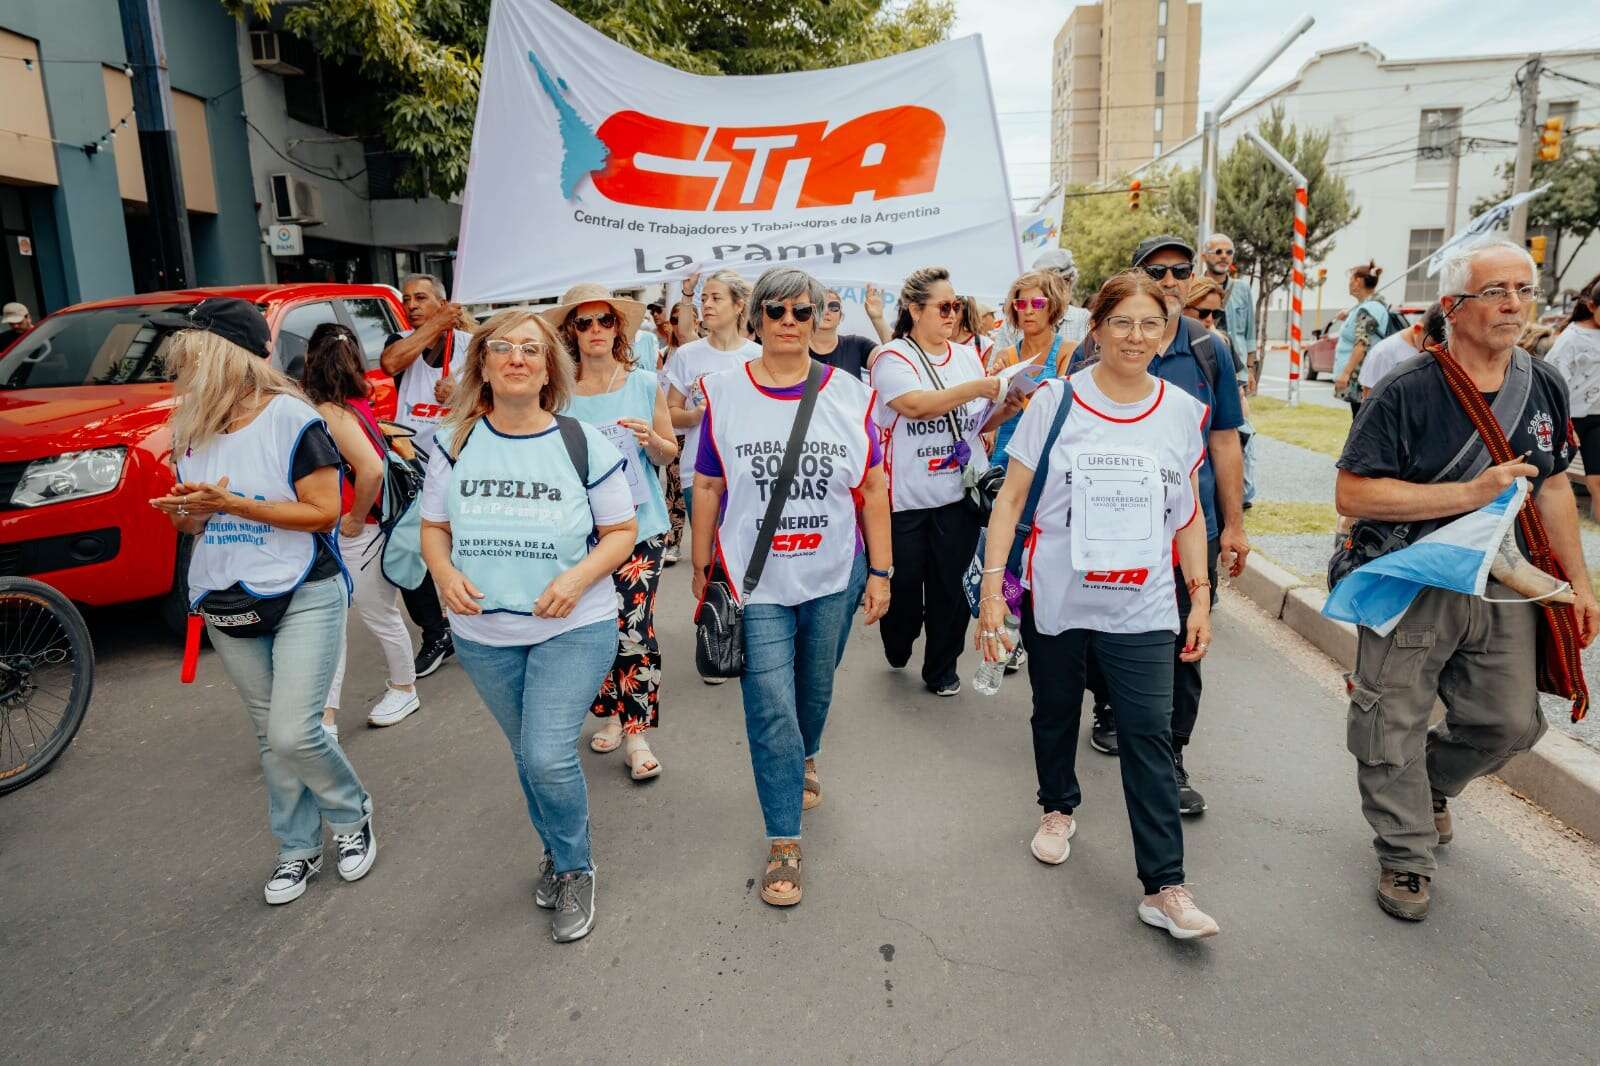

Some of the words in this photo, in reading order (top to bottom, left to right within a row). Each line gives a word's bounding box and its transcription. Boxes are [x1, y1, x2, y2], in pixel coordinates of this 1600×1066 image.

[591, 104, 946, 211] CTA
[574, 209, 624, 230] Central
[628, 219, 645, 232] de
[648, 221, 737, 237] Trabajadores
[740, 224, 749, 235] y
[841, 216, 858, 225] de
[860, 212, 872, 224] la
[875, 205, 941, 223] Argentina
[633, 248, 694, 274] La
[735, 440, 847, 458] TRABADORAS
[751, 454, 833, 478] SOOS
[1088, 456, 1145, 467] URGENTE
[460, 479, 562, 501] UTELPa
[756, 514, 829, 531] GNEROS
[473, 538, 521, 548] DEFENSA
[524, 541, 538, 549] DE
[542, 542, 555, 550] LA
[772, 532, 822, 552] CTA
[515, 549, 558, 561] PÚBLICA
[1084, 568, 1149, 586] CTA
